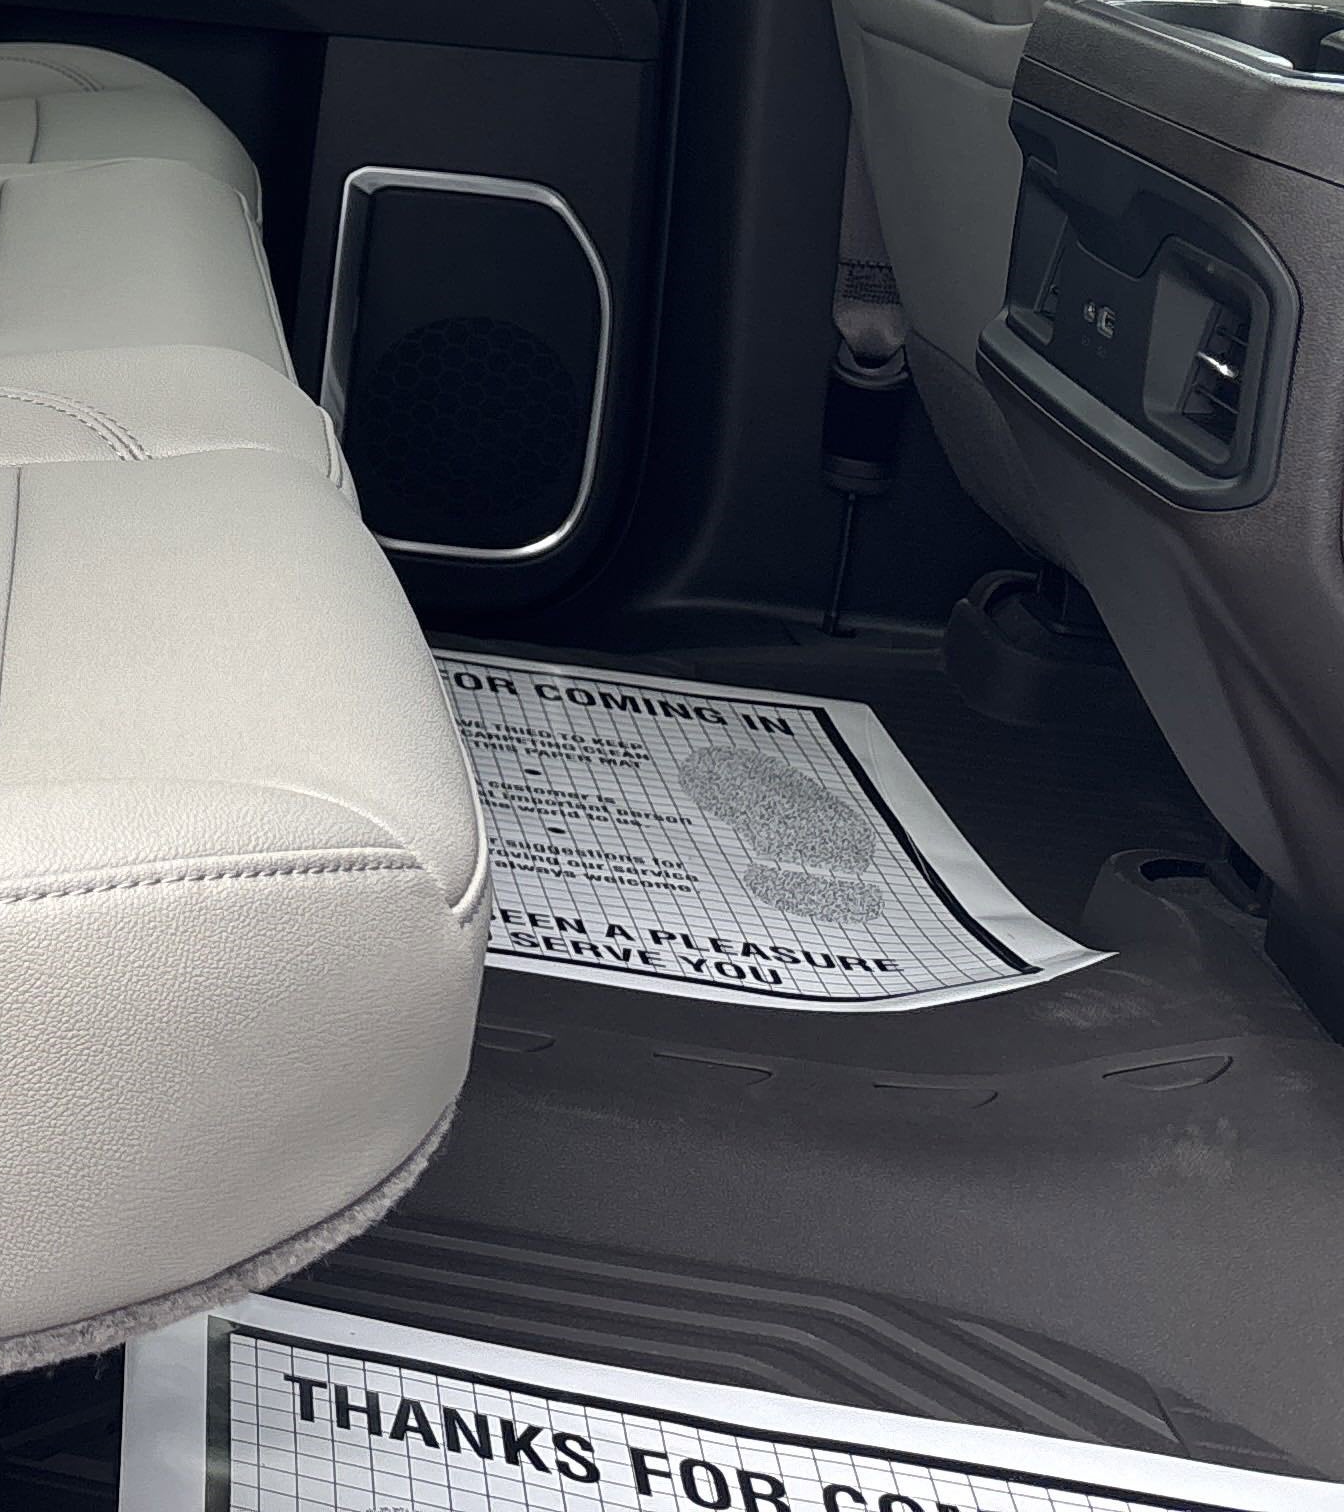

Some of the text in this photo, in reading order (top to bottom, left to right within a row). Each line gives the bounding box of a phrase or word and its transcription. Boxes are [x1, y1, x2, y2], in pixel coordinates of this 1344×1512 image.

[533, 683, 729, 726] COMING
[742, 713, 795, 737] IN
[461, 728, 650, 761] CARPETING CLEAN
[494, 723, 552, 738] TRIED
[558, 732, 585, 744] TO
[592, 737, 643, 751] KEEP
[474, 740, 642, 769] THIS PAPER MAT
[488, 780, 588, 801] customer
[596, 794, 617, 805] is
[502, 791, 610, 813] important
[616, 807, 693, 826] person
[517, 804, 581, 820] world
[586, 812, 609, 823] to
[488, 846, 700, 884] roving our service
[494, 859, 577, 879] always
[505, 838, 647, 866] suggestions
[652, 856, 686, 870] for
[491, 908, 905, 973] EEN A PLEASURE
[510, 931, 784, 986] SERVE YOU
[283, 1373, 793, 1512] THANKS FOR
